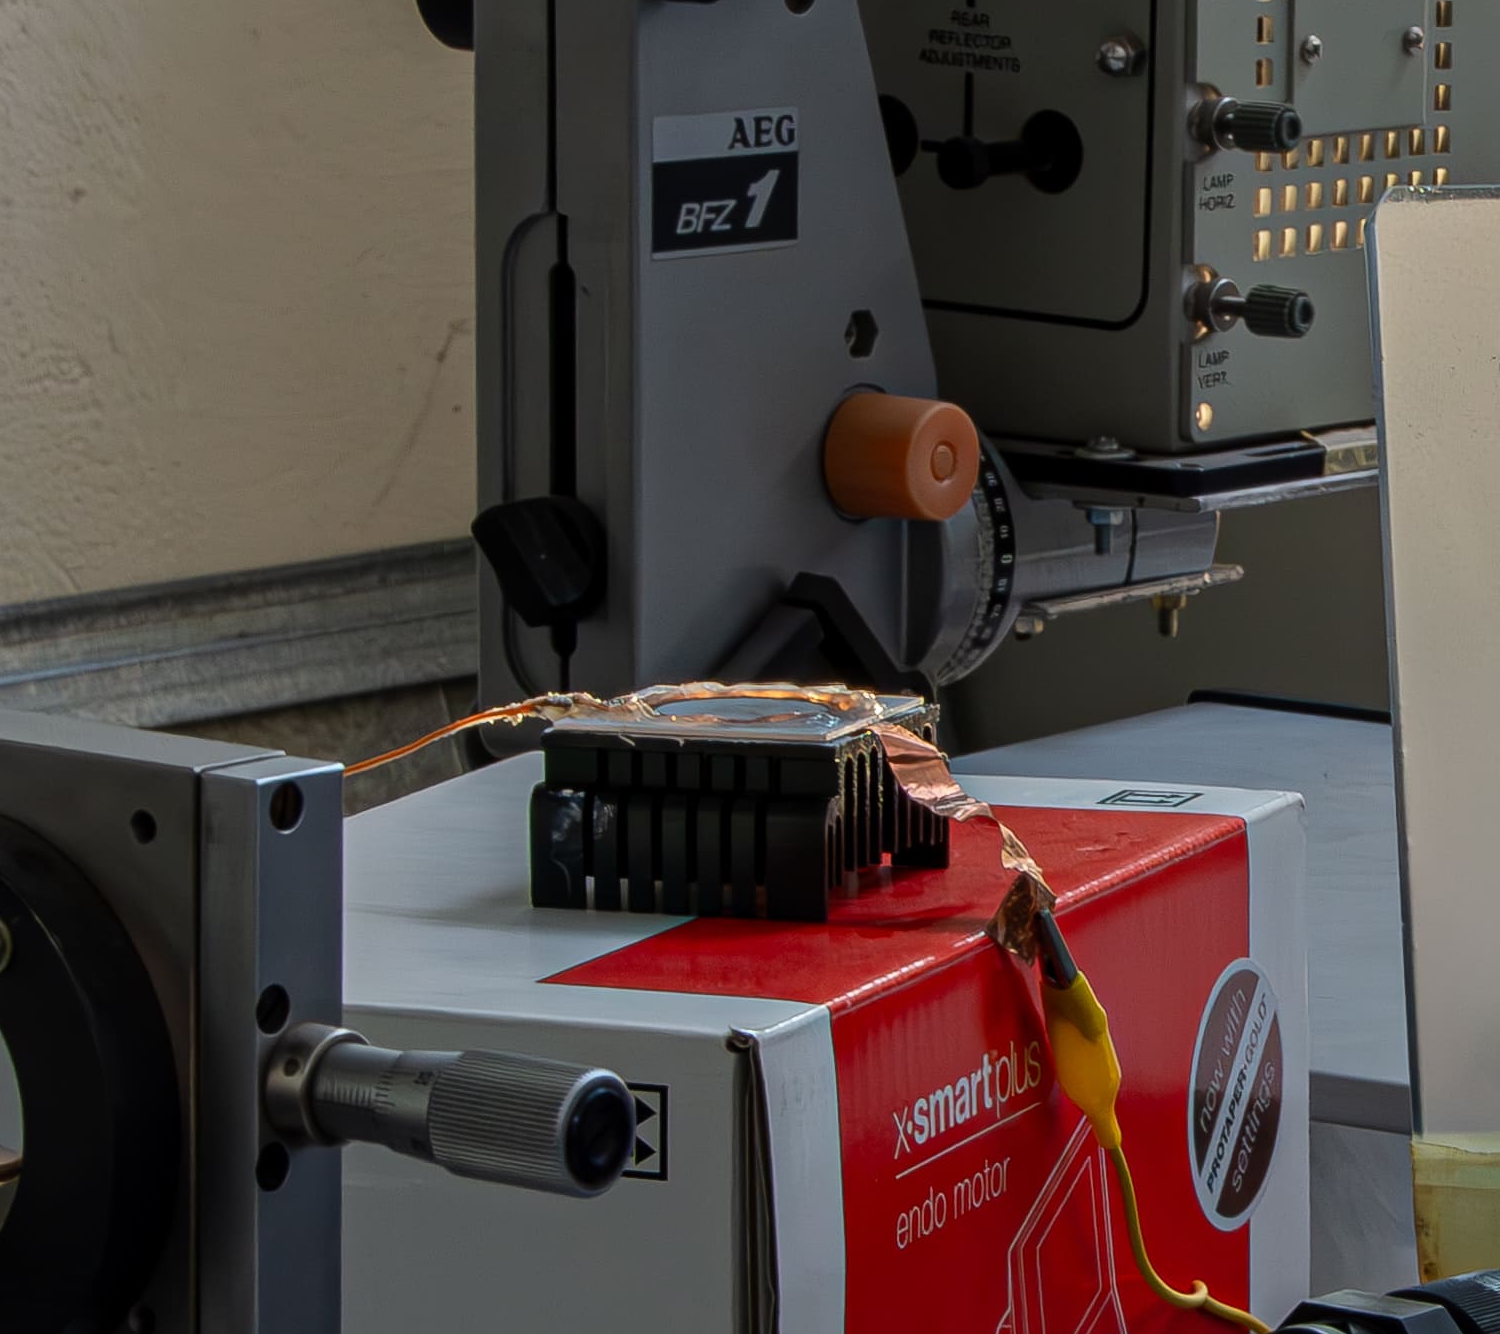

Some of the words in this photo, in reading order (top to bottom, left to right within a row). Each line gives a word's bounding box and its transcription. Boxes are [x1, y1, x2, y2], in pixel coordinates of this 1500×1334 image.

[950, 9, 990, 27] REAR
[929, 28, 1011, 50] REFLECTOR
[919, 48, 1021, 73] ADJUSTMENTS
[728, 114, 796, 150] AEG
[1203, 173, 1235, 191] LAMP
[675, 198, 738, 235] BFZ
[744, 168, 781, 229] 1
[1198, 350, 1230, 368] LAMP
[1199, 1059, 1223, 1134] now
[1221, 988, 1248, 1056] with
[1232, 1061, 1275, 1193] settings
[896, 1184, 947, 1250] endo
[953, 1156, 1011, 1219] motor
